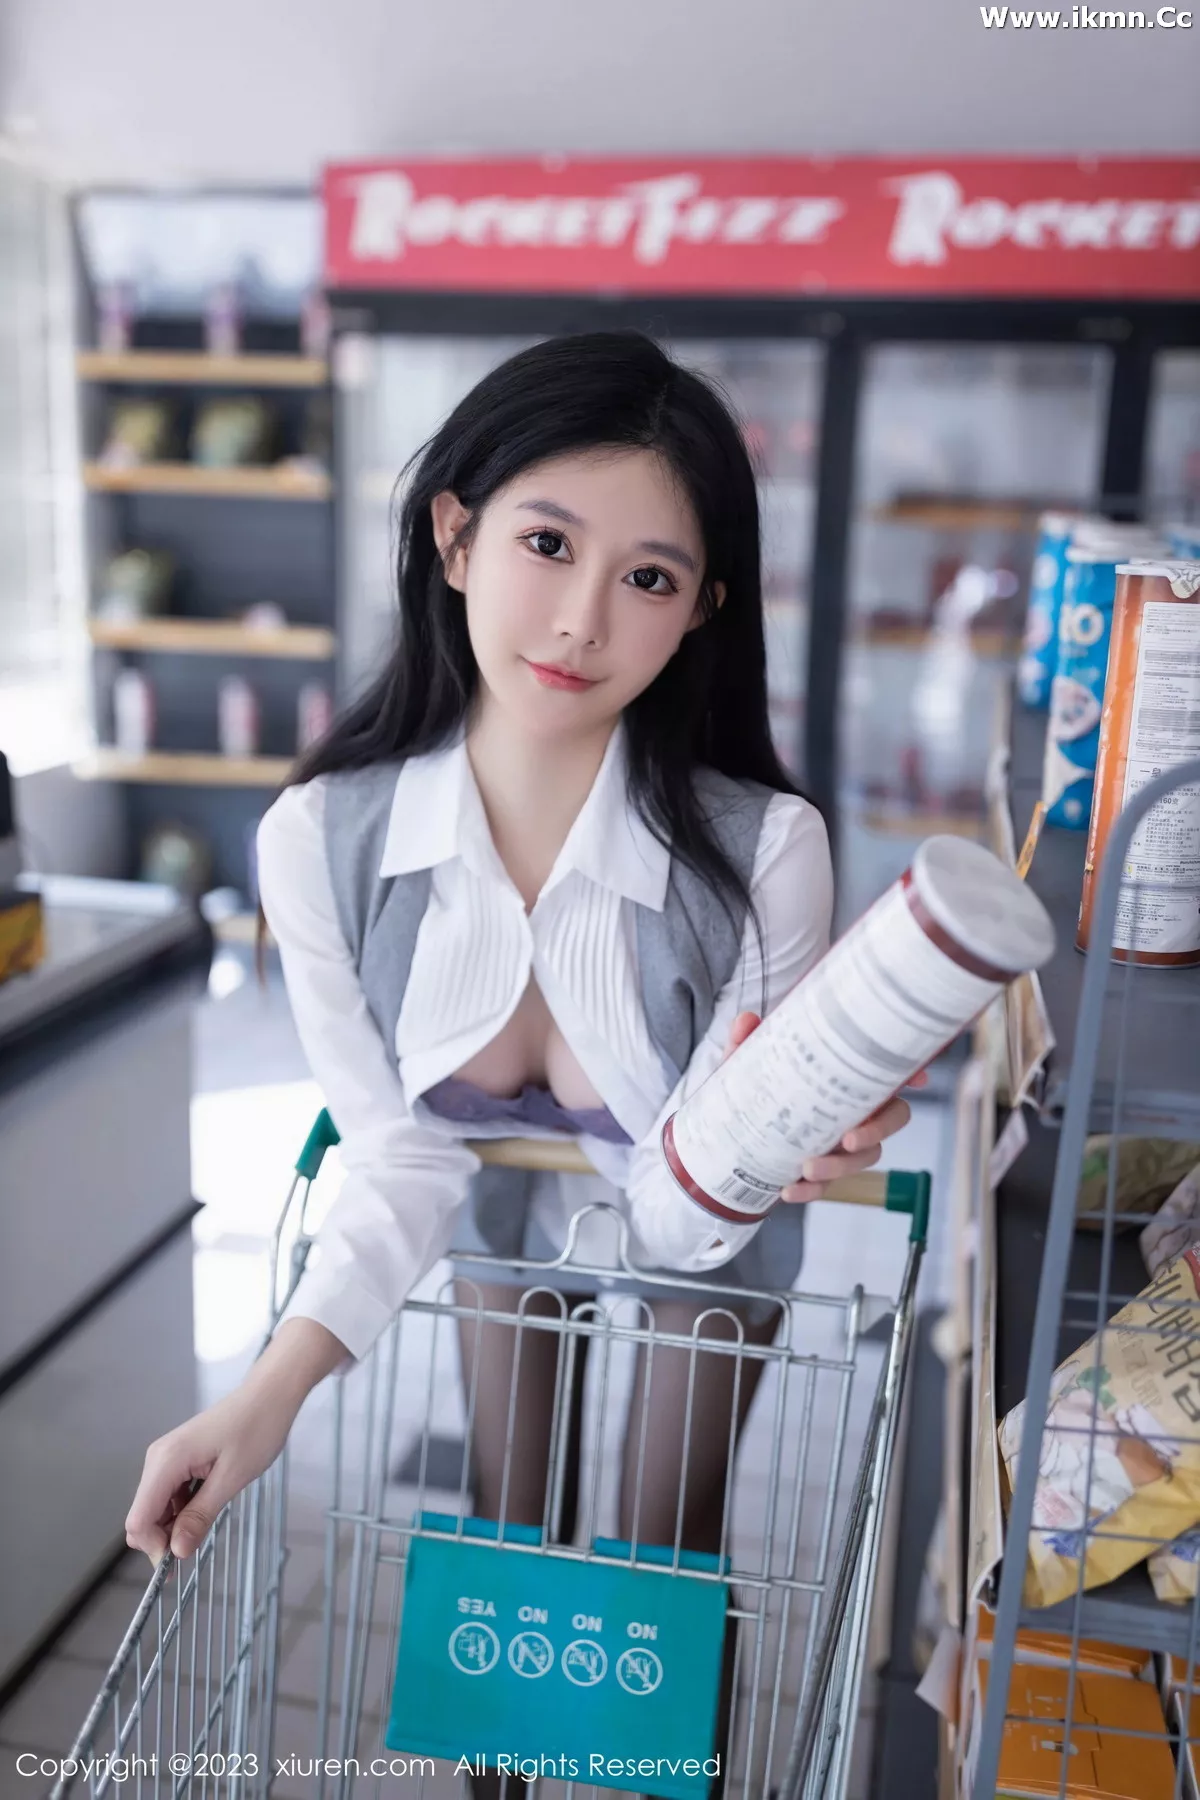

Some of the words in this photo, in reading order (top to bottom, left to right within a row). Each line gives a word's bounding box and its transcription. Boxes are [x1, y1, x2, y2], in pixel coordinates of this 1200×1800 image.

[456, 1596, 497, 1618] YES
[517, 1605, 549, 1625] NO
[571, 1613, 602, 1633] NO
[626, 1622, 658, 1641] NO
